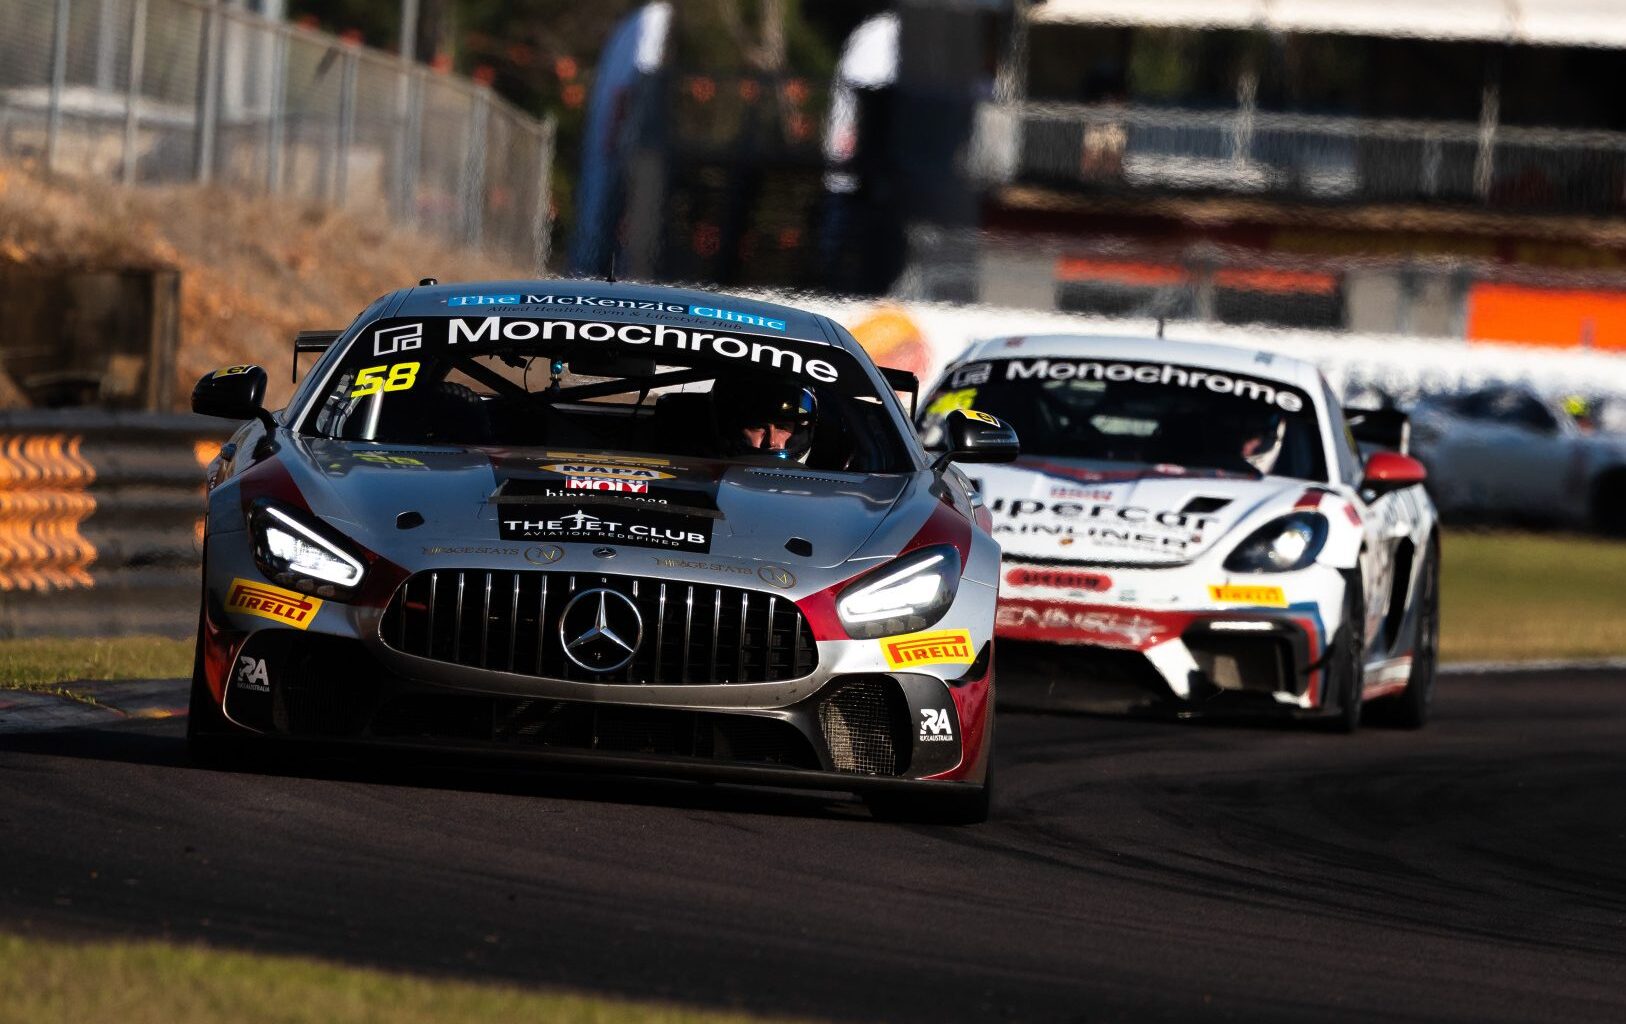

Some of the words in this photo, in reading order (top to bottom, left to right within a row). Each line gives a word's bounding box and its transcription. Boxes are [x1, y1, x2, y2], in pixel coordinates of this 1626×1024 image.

[453, 294, 516, 305] The
[525, 295, 685, 313] McKenzie
[693, 307, 784, 330] Clinic
[488, 305, 526, 313] Allied
[648, 312, 709, 326] Lifestyle
[712, 319, 742, 330] Hub
[448, 317, 839, 383] Monochrome
[351, 361, 421, 398] 58
[1005, 359, 1304, 412] Monochrome
[562, 465, 655, 478] NAPA
[569, 479, 647, 494] MOLY
[991, 498, 1219, 529] upercar
[504, 520, 563, 531] THE
[569, 517, 622, 531] JET
[629, 525, 706, 544] CLUB
[598, 531, 680, 547] REDEFINED
[991, 524, 1189, 548] AINLINER
[229, 584, 313, 622] PIRELLI
[887, 635, 969, 664] PIRELLI
